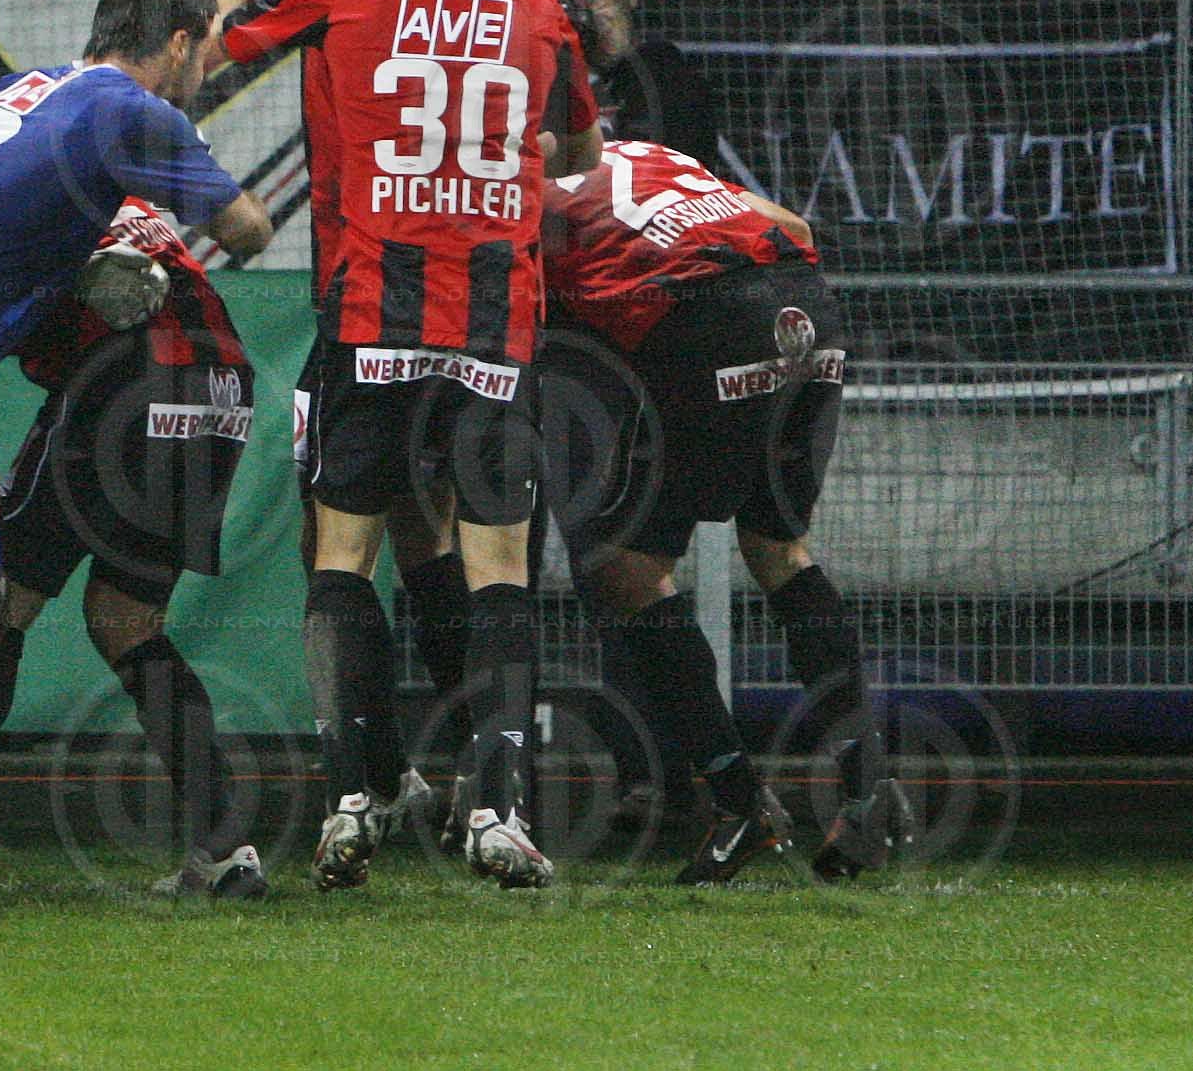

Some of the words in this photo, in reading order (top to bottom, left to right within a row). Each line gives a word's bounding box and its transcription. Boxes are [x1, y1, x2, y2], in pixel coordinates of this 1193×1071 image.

[400, 7, 504, 45] AVE
[373, 58, 529, 180] 30
[371, 175, 522, 221] PICHLER
